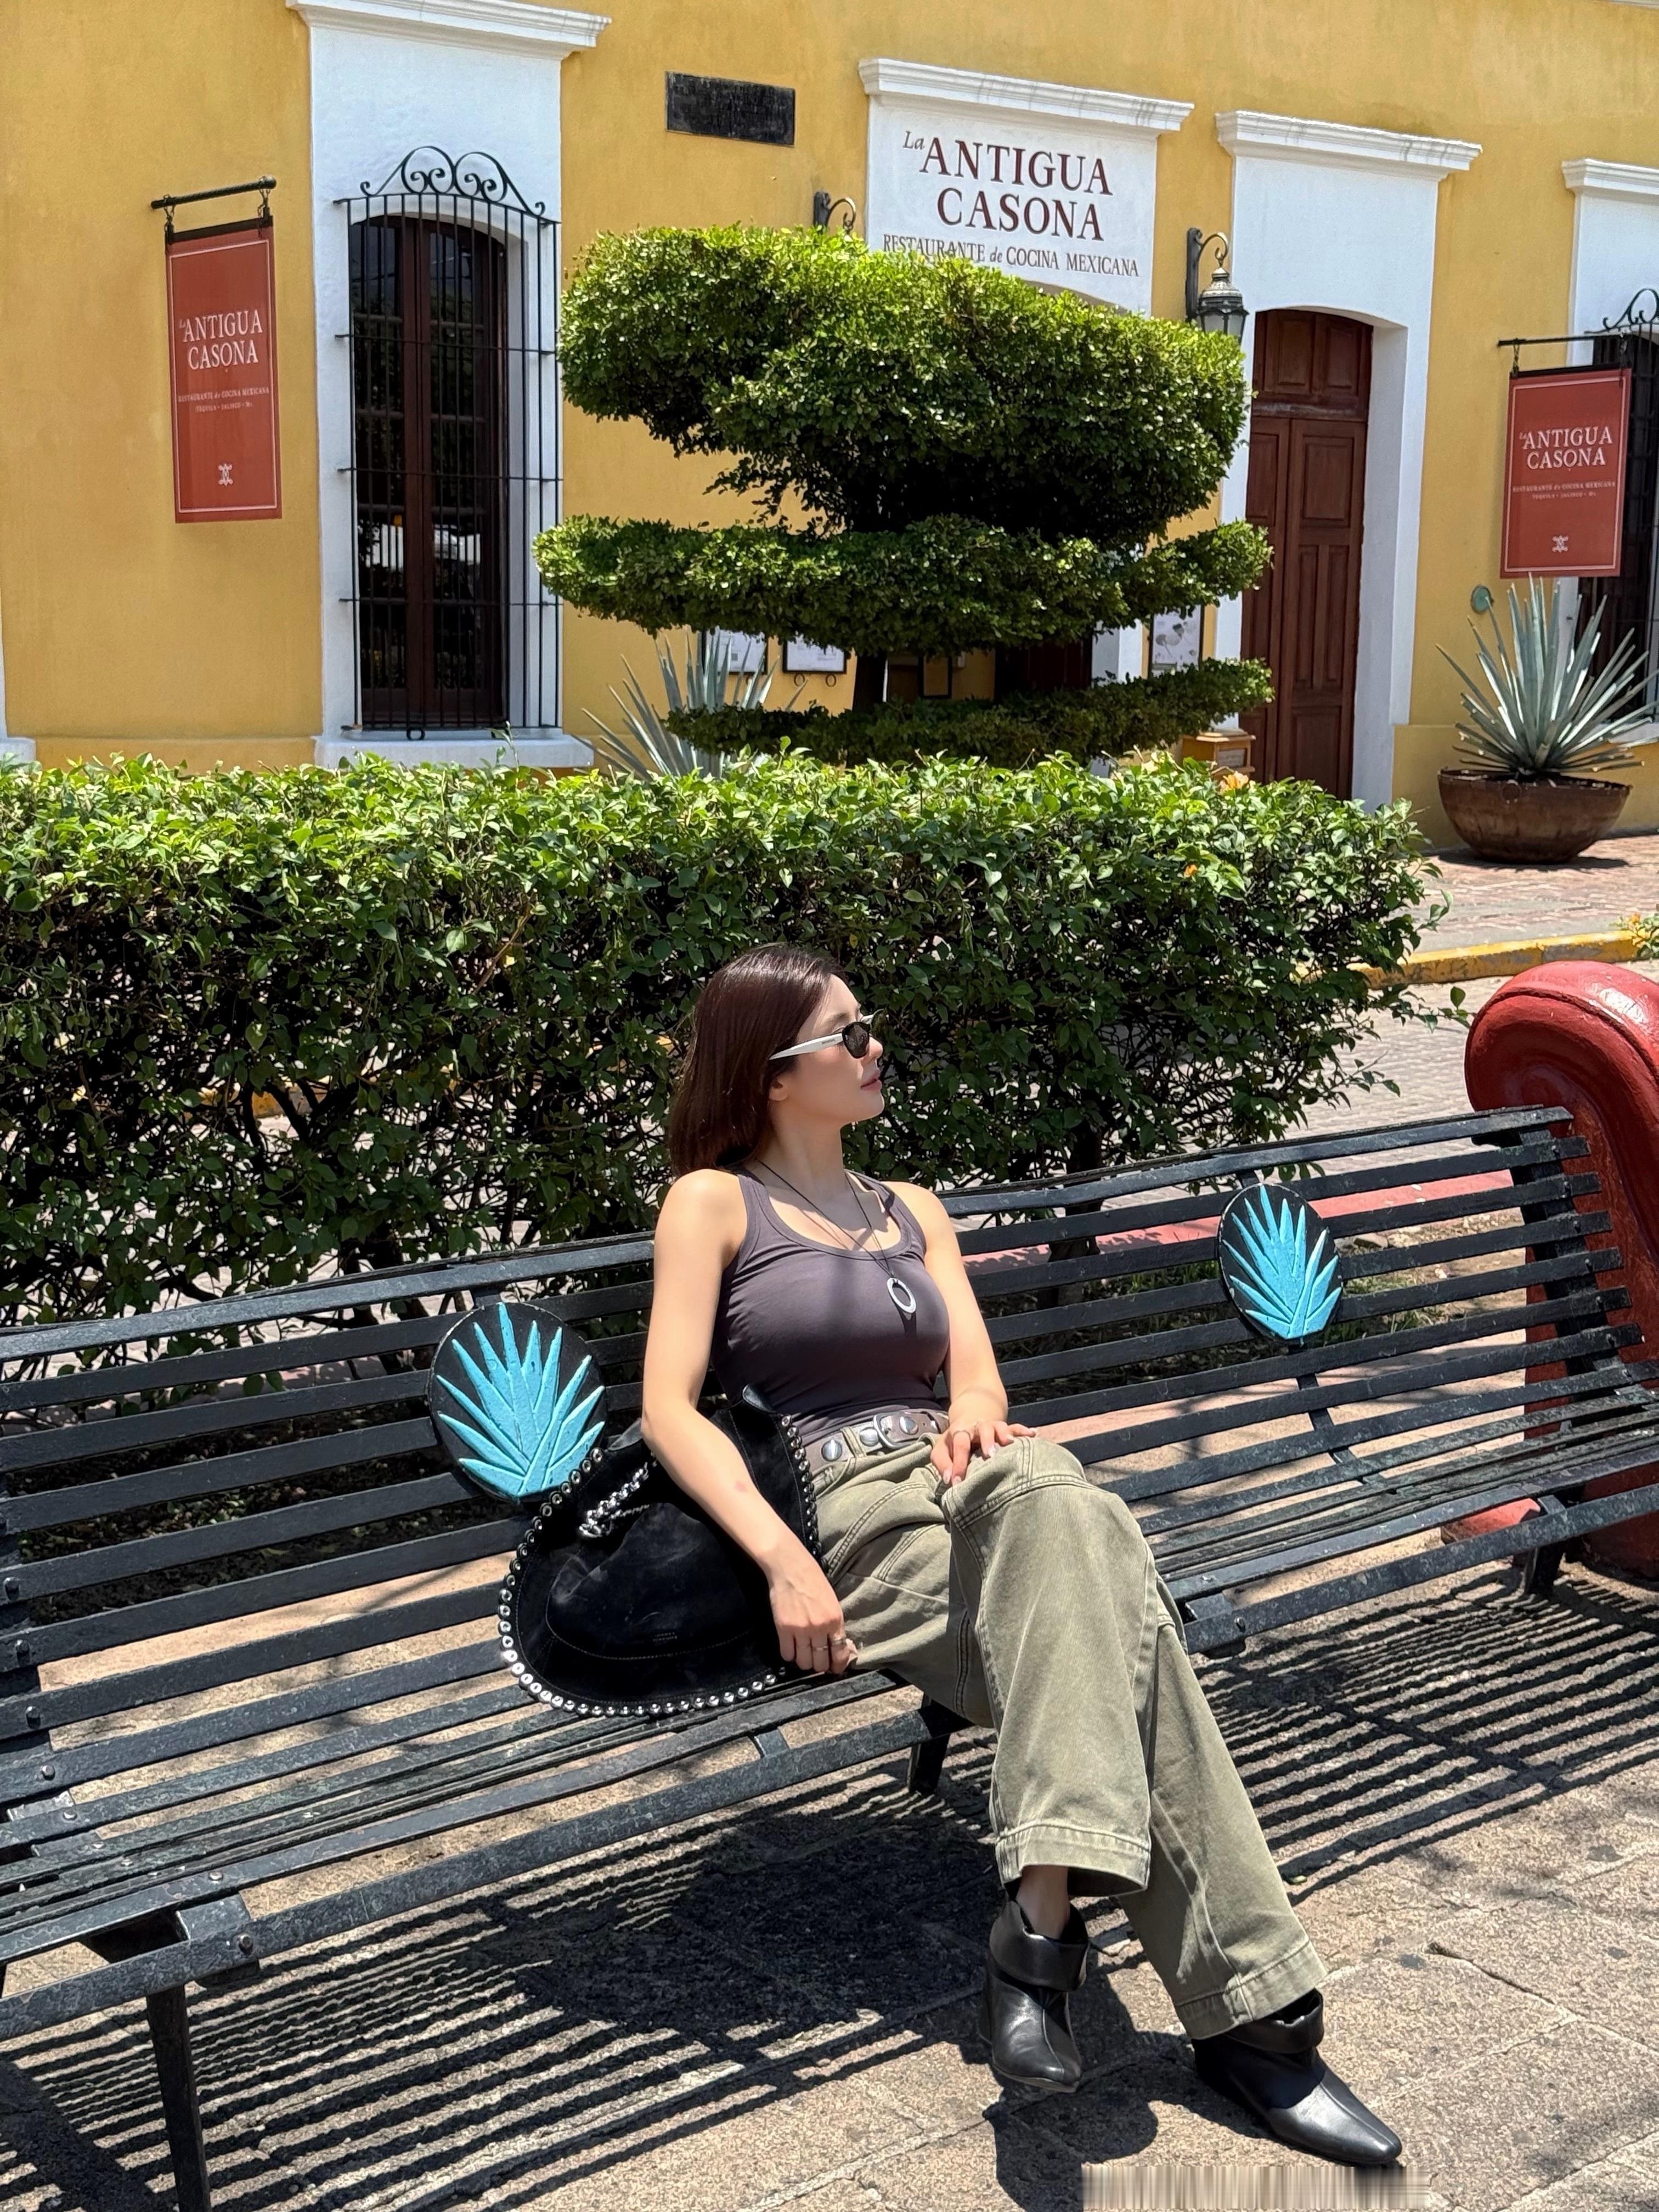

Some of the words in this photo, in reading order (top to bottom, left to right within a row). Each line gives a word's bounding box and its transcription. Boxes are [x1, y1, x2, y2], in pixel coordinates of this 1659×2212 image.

[903, 131, 924, 150] La
[919, 137, 1113, 196] ANTIGUA
[938, 188, 1104, 241] CASONA
[883, 234, 985, 263] RESTAURANTE
[990, 246, 1003, 263] de
[1006, 246, 1060, 270] COCINA
[1066, 252, 1139, 277] MEXICANA
[183, 309, 263, 343] ANTIGUA
[188, 339, 259, 370] CASONA
[1522, 426, 1613, 450] ANTIGUA
[1527, 447, 1606, 470] CASONA
